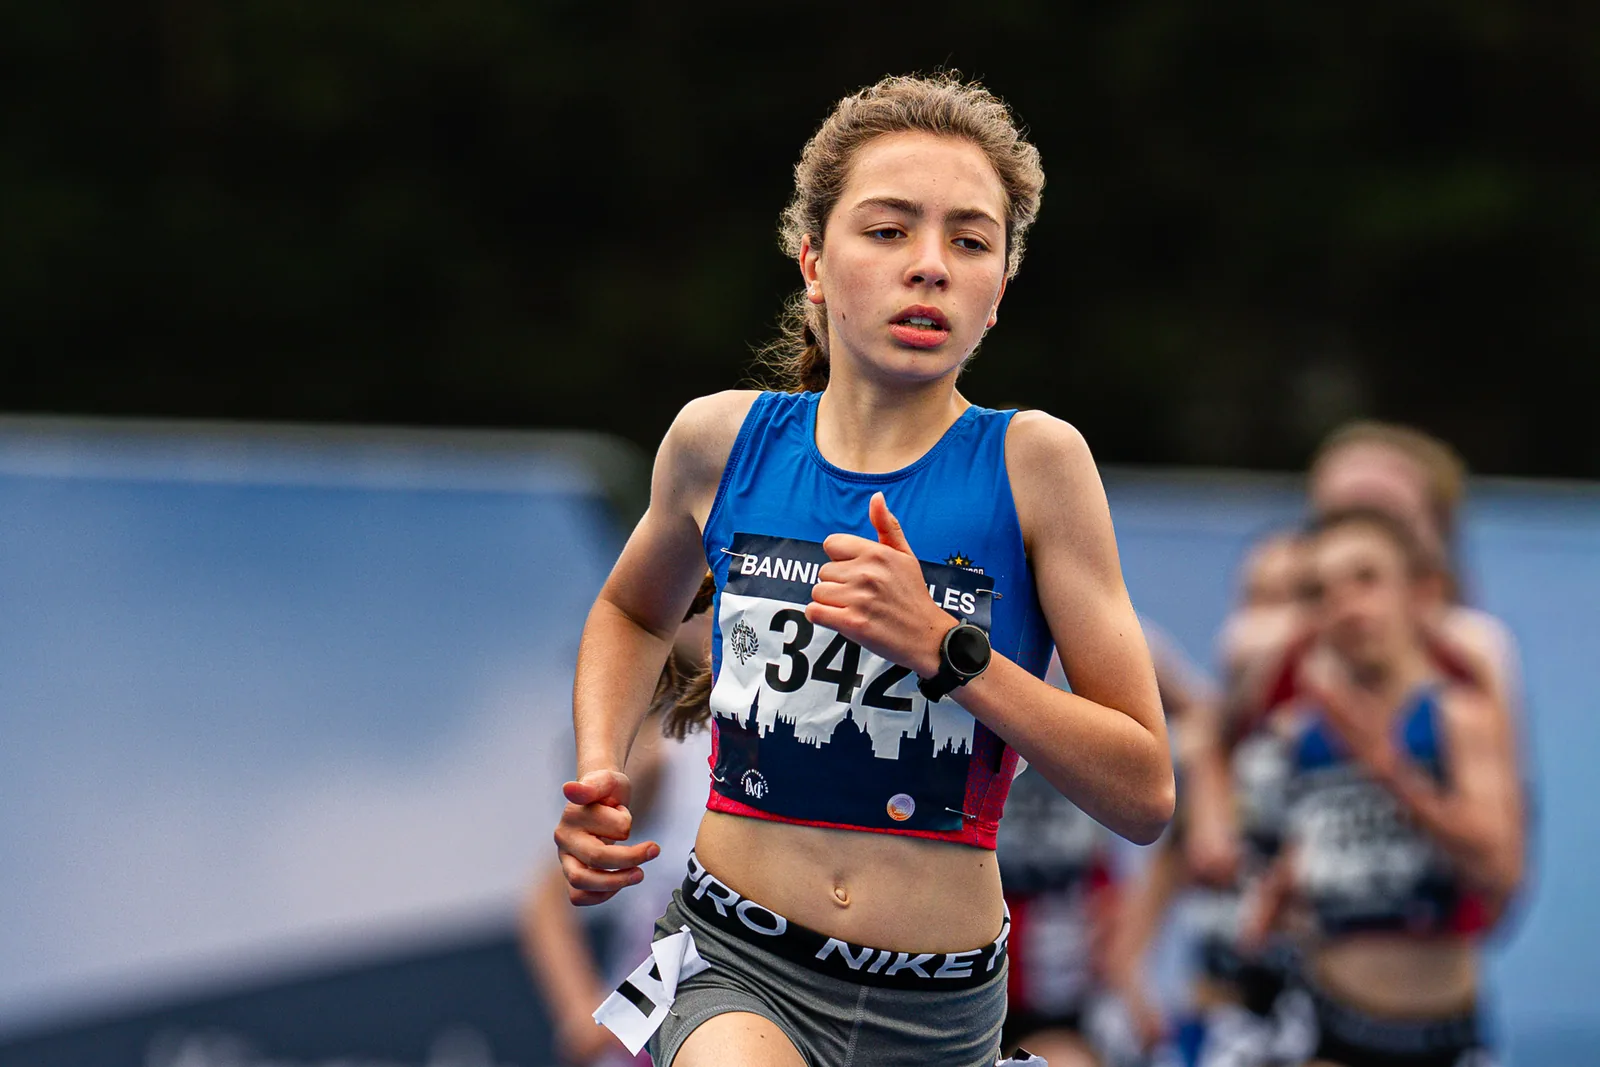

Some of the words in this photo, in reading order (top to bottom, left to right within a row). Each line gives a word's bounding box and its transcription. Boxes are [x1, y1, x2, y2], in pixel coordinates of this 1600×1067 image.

[740, 554, 821, 585] BANNI
[925, 583, 976, 615] LES
[764, 608, 913, 713] 342
[815, 937, 982, 979] NIKE
